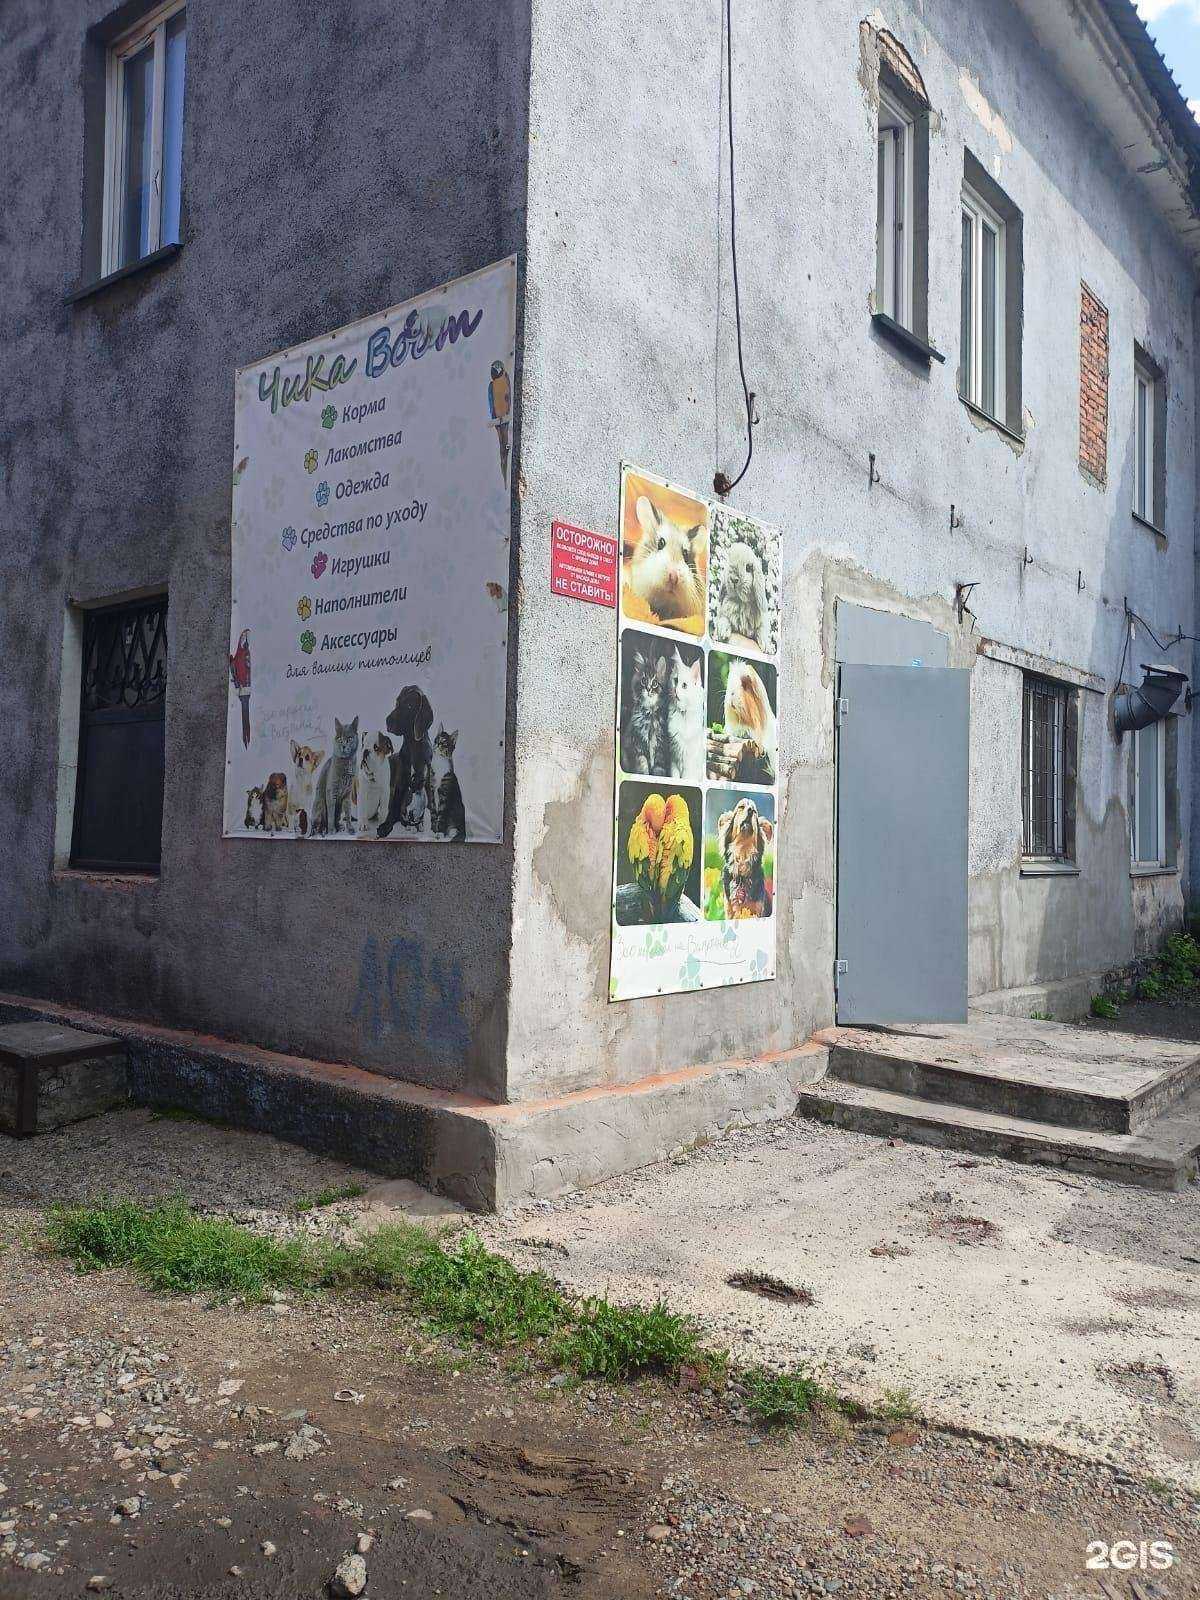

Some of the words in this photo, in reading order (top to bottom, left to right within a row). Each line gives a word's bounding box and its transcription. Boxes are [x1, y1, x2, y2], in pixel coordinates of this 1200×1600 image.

[342, 397, 386, 424] Корма
[324, 430, 403, 466] Лакомства
[335, 471, 390, 500] Одежда
[300, 518, 363, 548] Средства
[366, 514, 383, 530] по
[386, 500, 428, 530] уходу
[556, 526, 615, 557] ОСТОРОЖНО!
[331, 551, 391, 577] Игрушки
[314, 586, 408, 616] Наполнители
[555, 576, 568, 590] НЕ
[570, 580, 614, 602] СТАВИТЬ!
[320, 627, 398, 651] Аксессуары
[286, 663, 309, 679] для
[312, 658, 354, 675] ваших
[358, 645, 432, 667] питомцев
